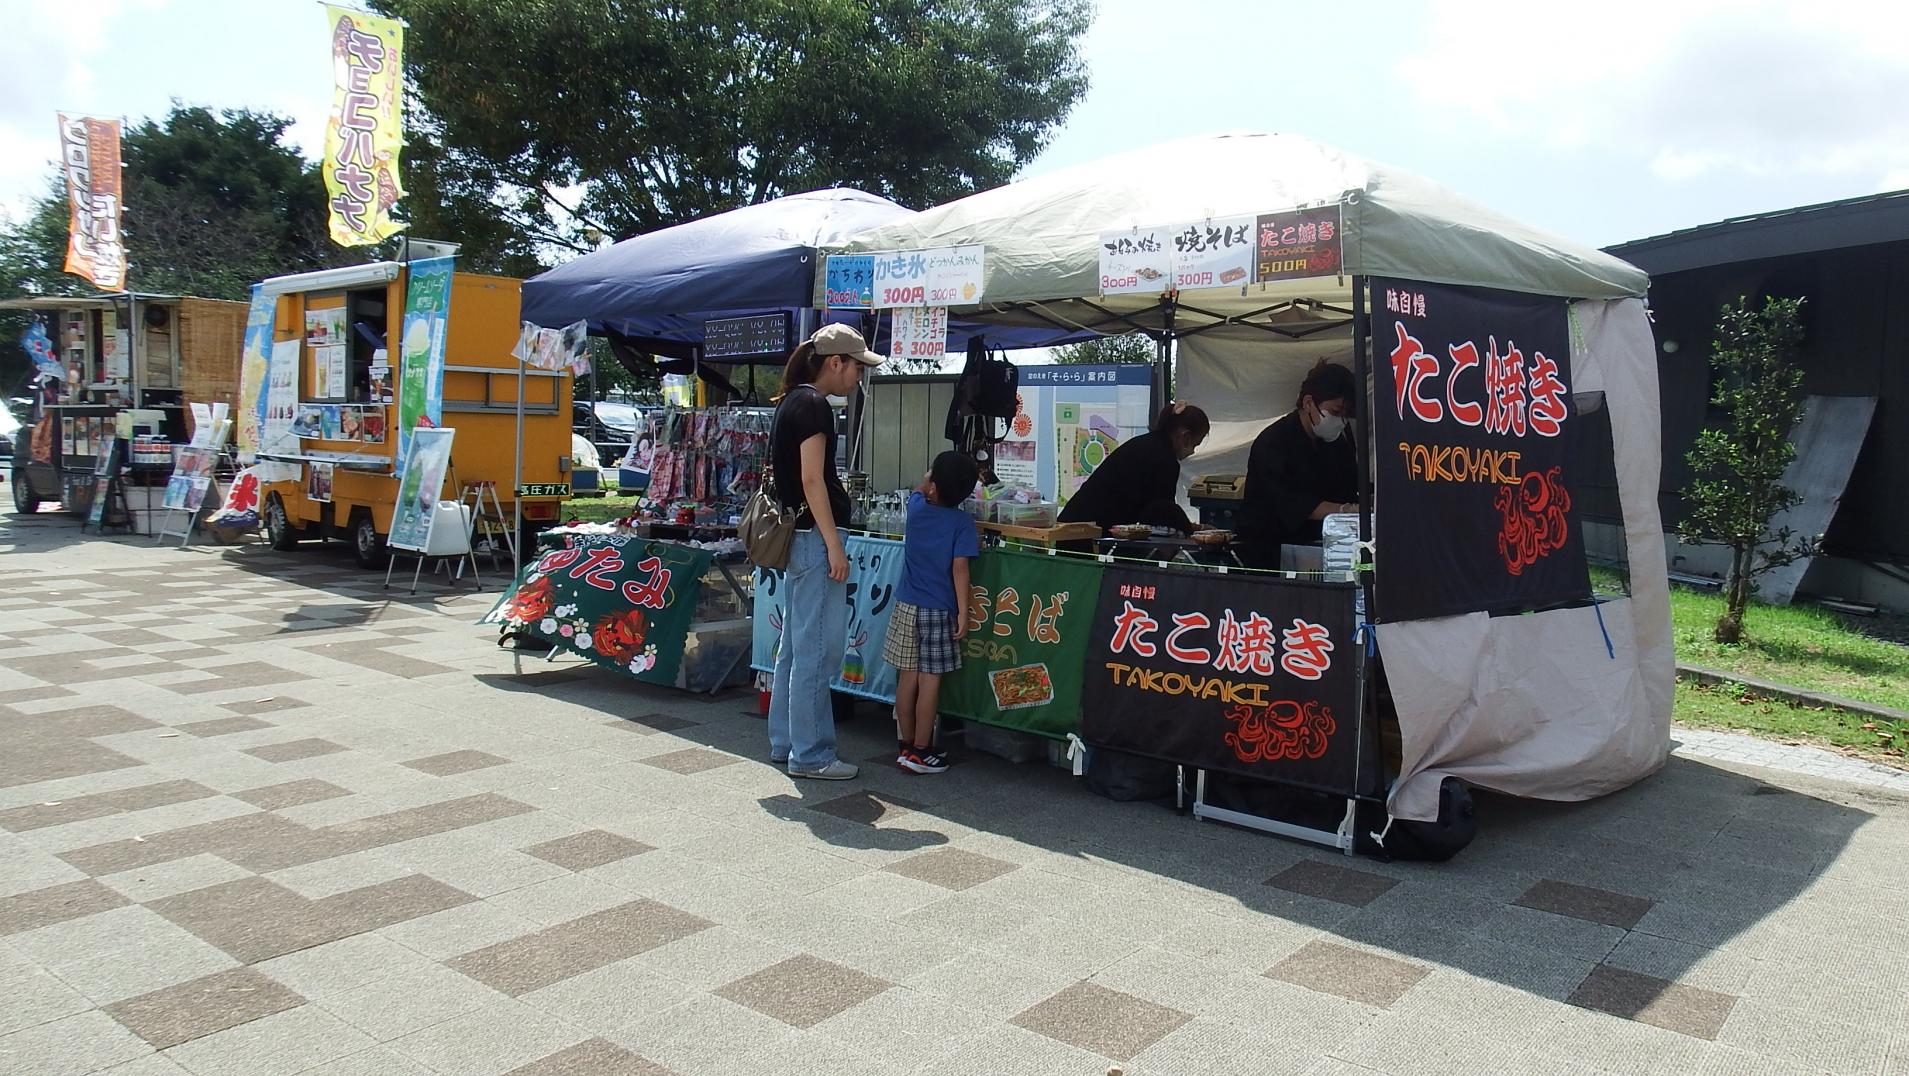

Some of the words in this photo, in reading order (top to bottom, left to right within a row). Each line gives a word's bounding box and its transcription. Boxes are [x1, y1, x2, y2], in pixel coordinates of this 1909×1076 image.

[1175, 224, 1249, 252] 焼そば
[1260, 221, 1335, 247] たこ焼き
[876, 253, 926, 280] かき氷
[1178, 272, 1212, 285] 300円
[1260, 259, 1306, 273] 500円
[884, 286, 924, 304] 300円
[931, 288, 957, 301] 300円
[1102, 275, 1137, 288] 300円
[1386, 288, 1426, 318] 味自慢
[922, 305, 930, 339] メロン
[930, 306, 938, 339] イチゴ
[938, 307, 946, 338] コーラ
[911, 341, 944, 356] 300円
[1389, 320, 1567, 437] たこ焼き
[1399, 441, 1522, 485] TAKOYAKI
[1120, 584, 1155, 600] 味自慢
[1109, 599, 1335, 681] たこ焼き
[1105, 662, 1270, 707] TAKOYAKI
